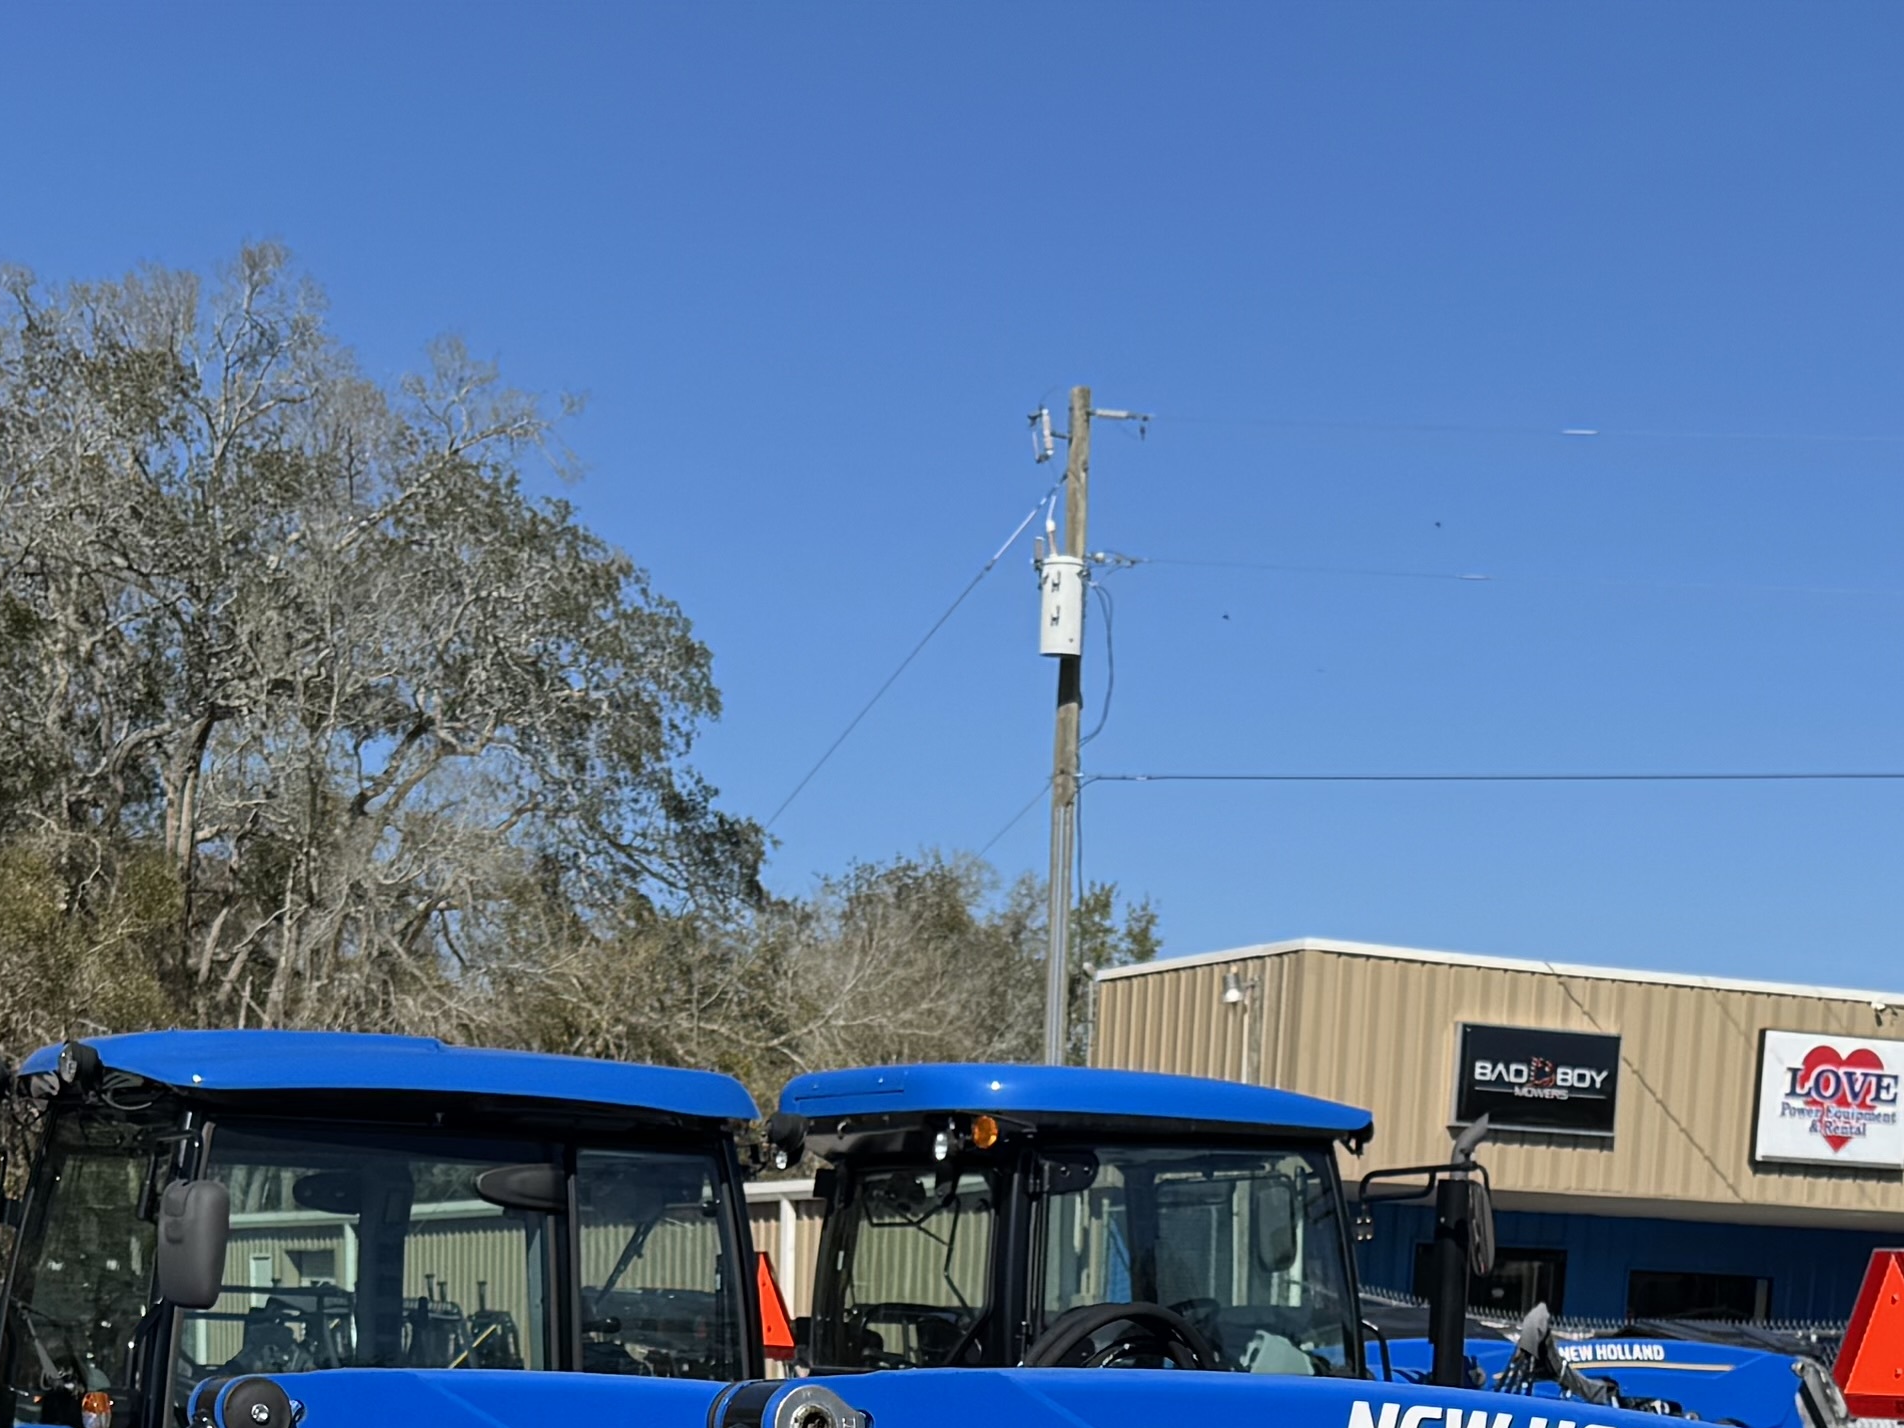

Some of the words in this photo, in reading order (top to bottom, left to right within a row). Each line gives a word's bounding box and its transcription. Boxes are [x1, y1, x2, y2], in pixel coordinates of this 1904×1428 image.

[1474, 1061, 1528, 1083] BAD
[1556, 1066, 1608, 1089] BOY
[1784, 1067, 1899, 1104] LOVE
[1513, 1086, 1569, 1100] MOWERS
[1780, 1102, 1822, 1118] Power
[1826, 1105, 1897, 1126] Equipment
[1809, 1119, 1820, 1134] &
[1825, 1121, 1867, 1136] Rental
[1559, 1345, 1593, 1363] NEW
[1595, 1343, 1665, 1361] HOLLAND
